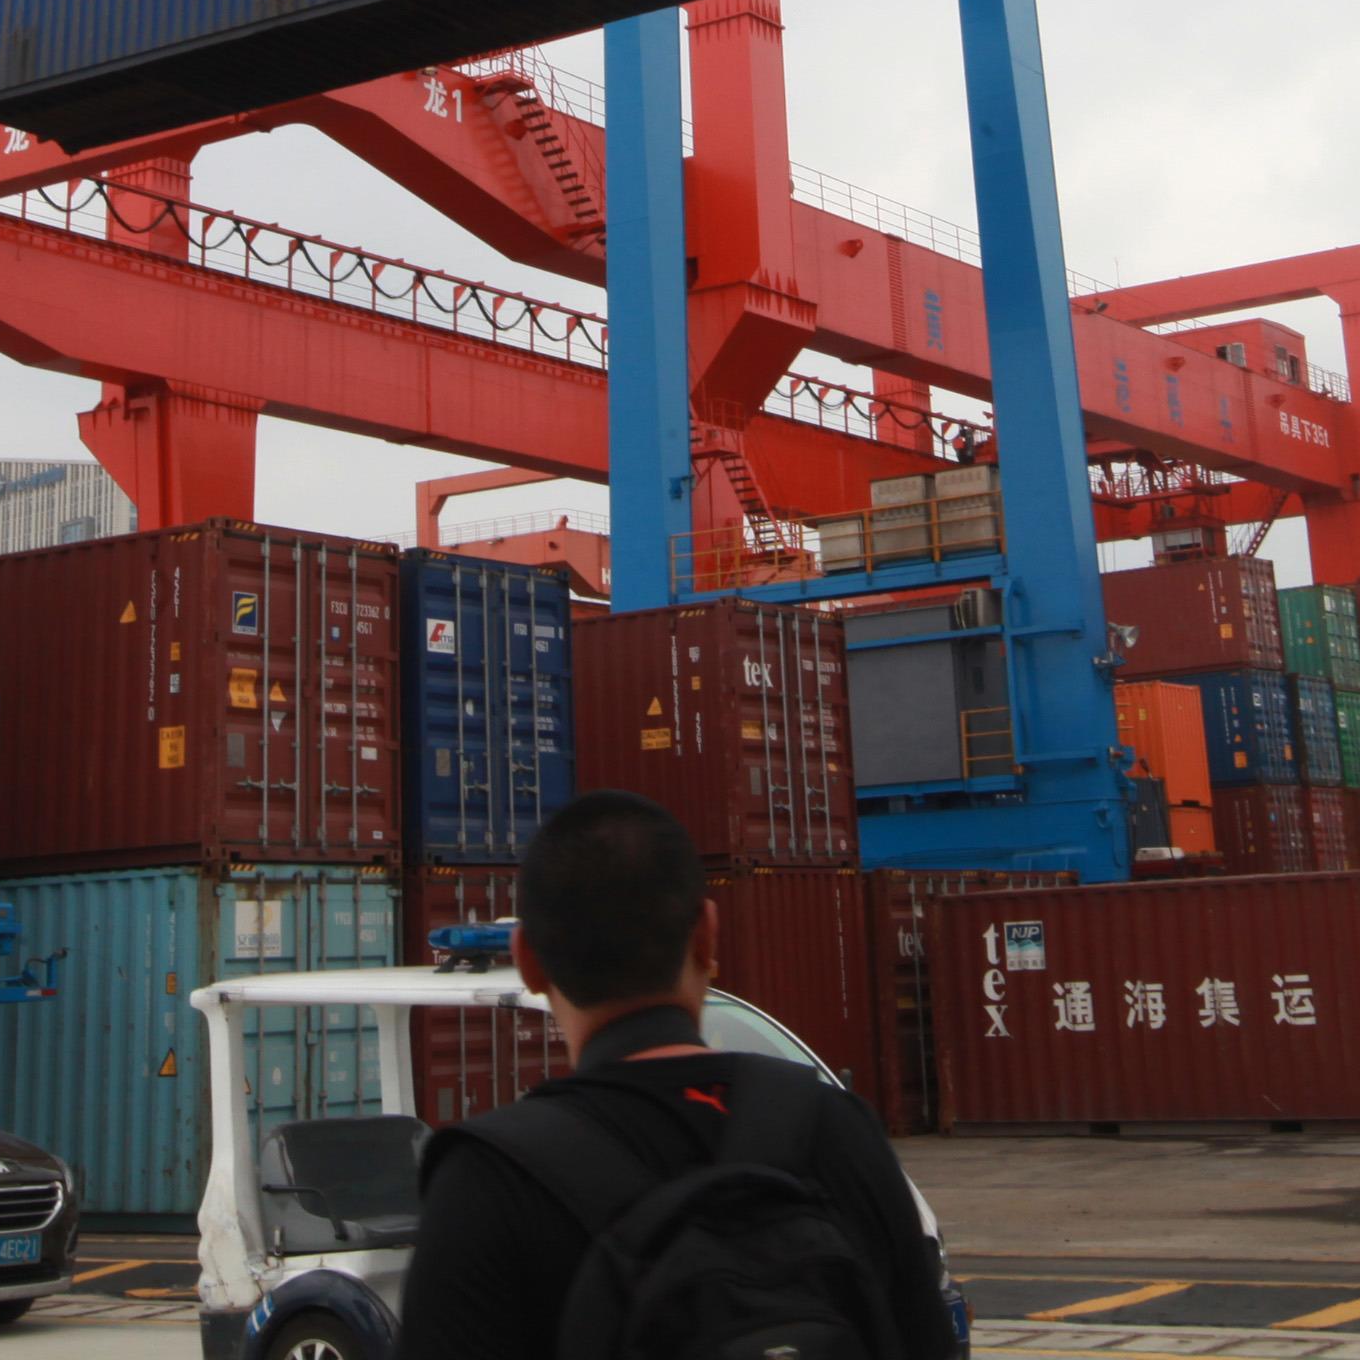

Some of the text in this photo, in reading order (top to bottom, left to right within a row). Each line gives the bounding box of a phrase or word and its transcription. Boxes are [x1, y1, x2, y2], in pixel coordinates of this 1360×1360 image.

[743, 654, 774, 688] tex
[897, 925, 925, 957] tex
[982, 922, 1010, 1038] tex
[1051, 973, 1317, 1033] 通海集运
